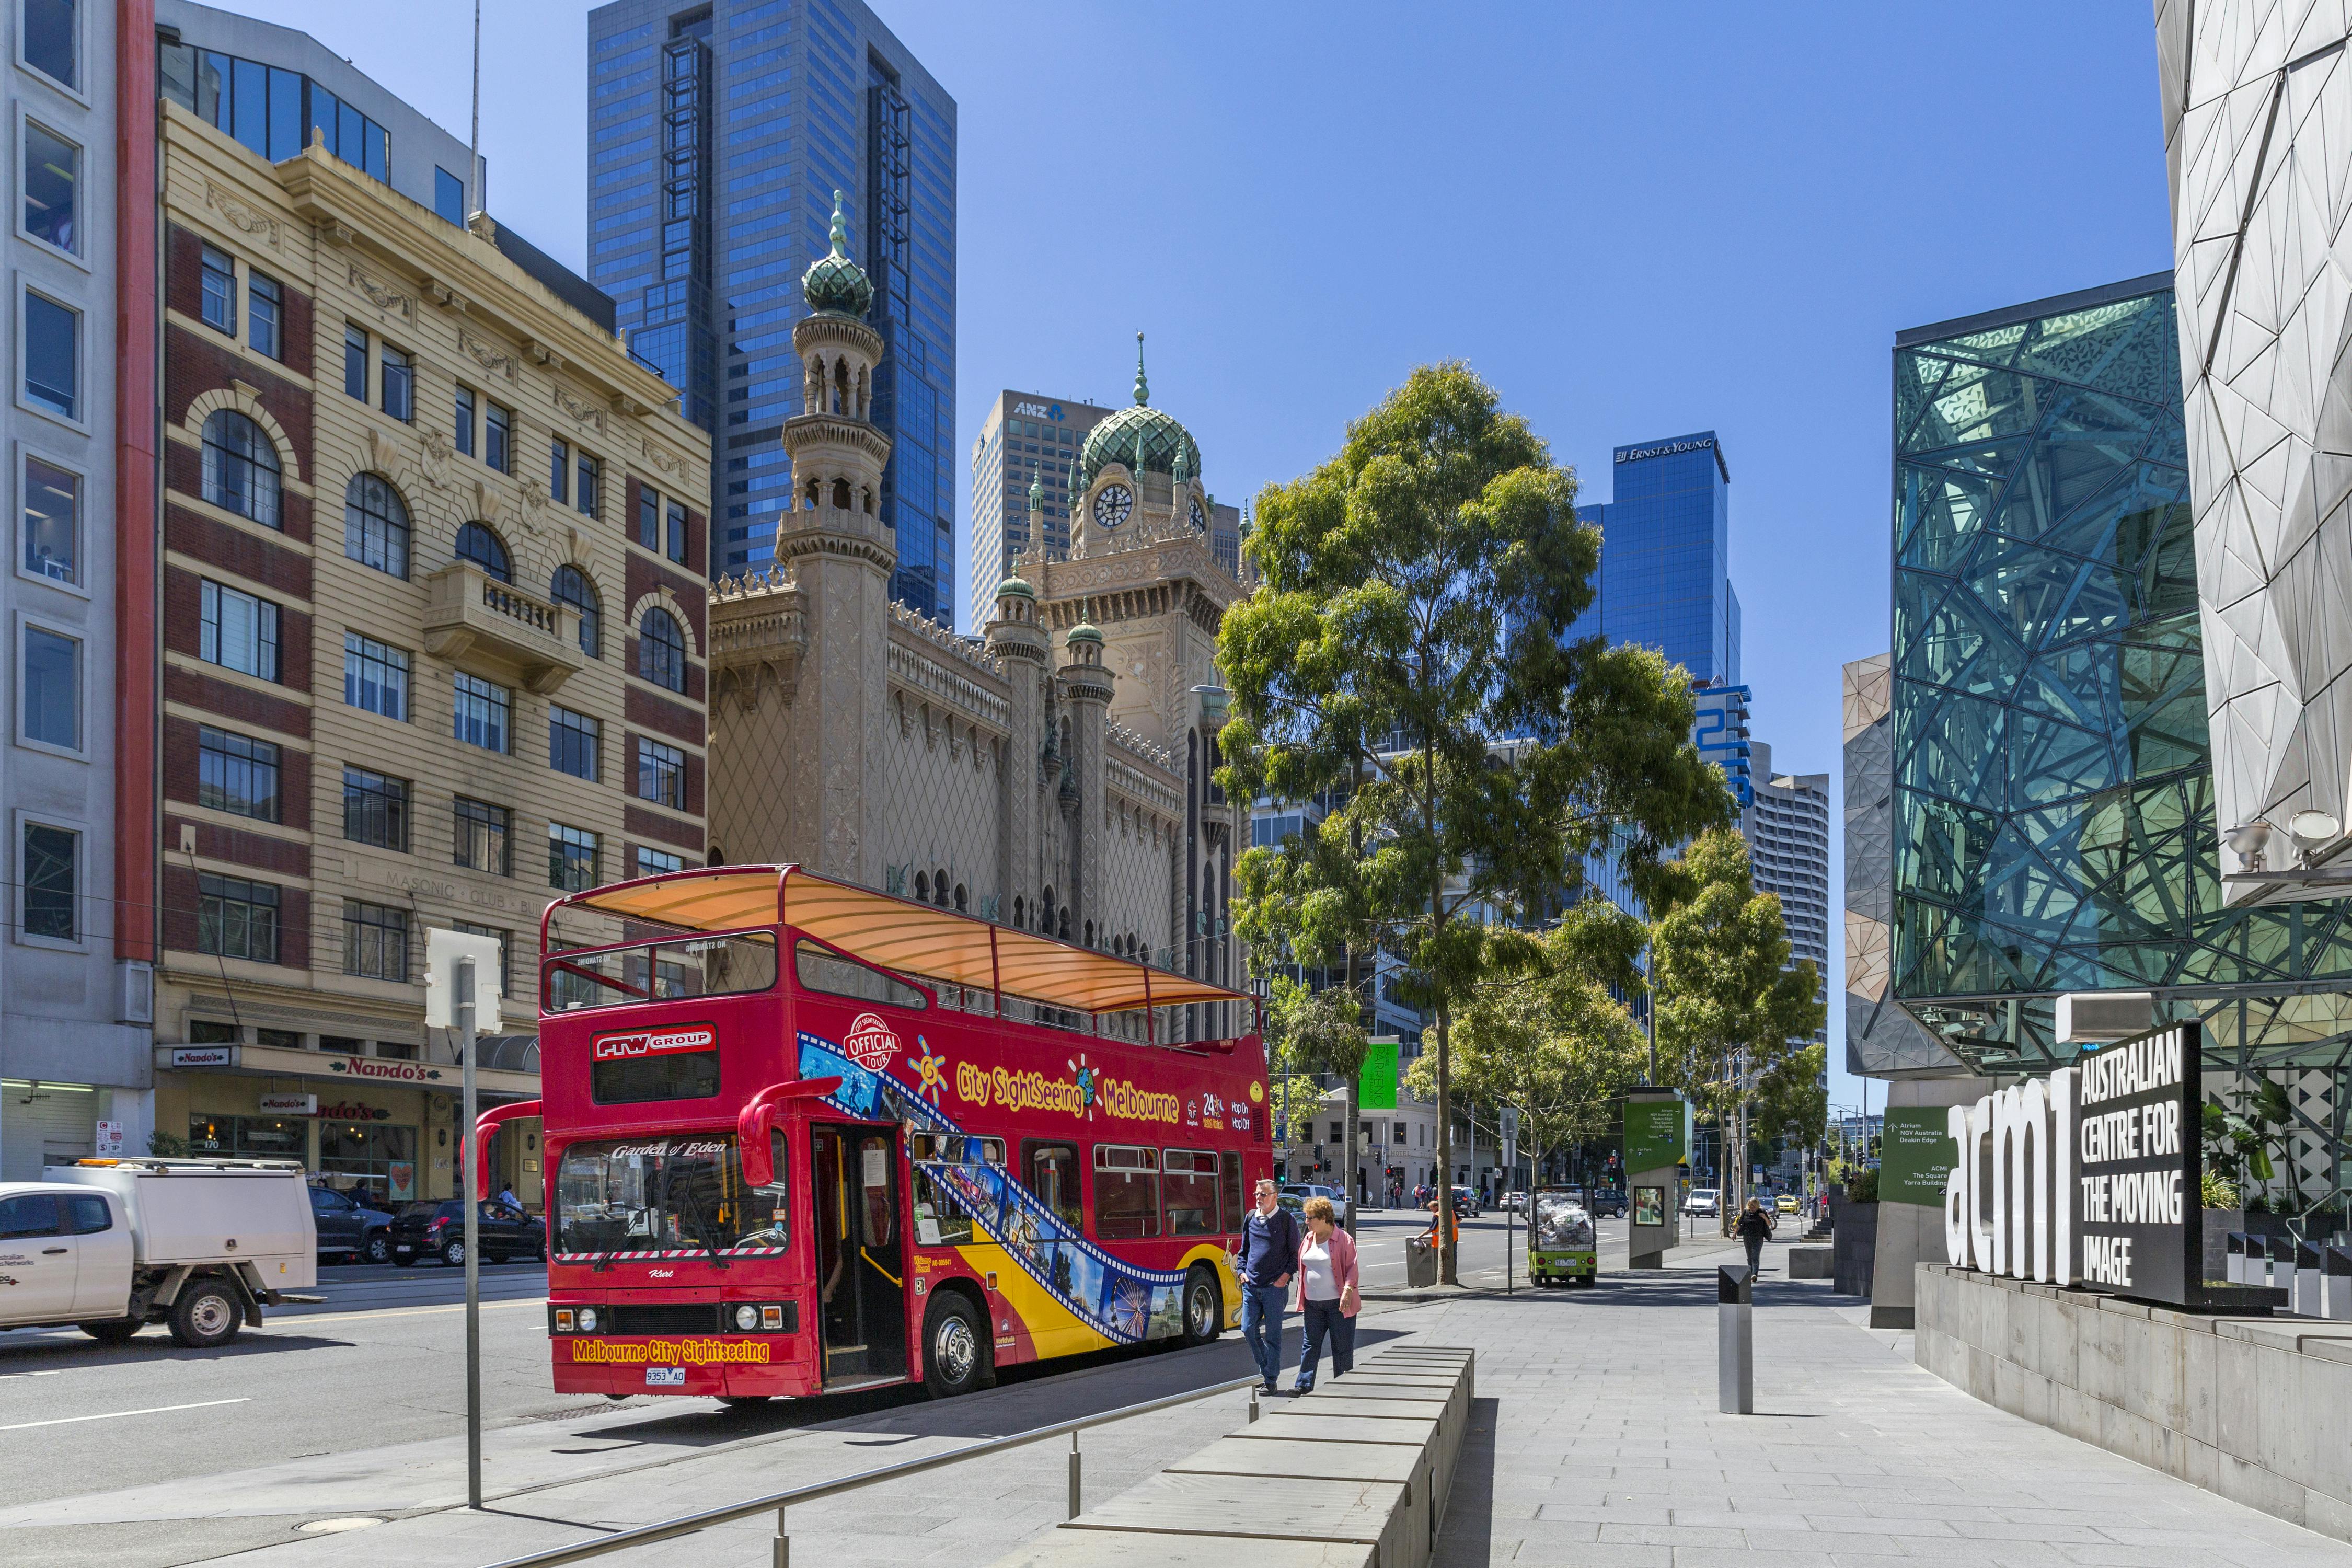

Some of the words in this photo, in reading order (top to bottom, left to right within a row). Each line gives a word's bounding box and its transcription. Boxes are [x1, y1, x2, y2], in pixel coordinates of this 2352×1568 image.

[1014, 402, 1047, 419] ANZ
[1629, 447, 1663, 460] ERNST
[1663, 445, 1670, 455] &
[1672, 438, 1712, 453] YOUNG
[386, 871, 455, 897] MASONIC
[471, 890, 505, 908] CLUB
[521, 900, 573, 922] BUILING
[862, 1018, 886, 1031] SIGHTSEEING
[653, 1034, 708, 1046] GROUP
[849, 1034, 898, 1055] OFFICIAL
[184, 1053, 217, 1063] Nando's
[866, 1053, 888, 1068] TOUR
[2081, 1028, 2183, 1106] AUSTRALIAN
[346, 1057, 426, 1080] Nando's
[1374, 1046, 1385, 1106] PARRENO
[957, 1061, 991, 1107] City
[993, 1066, 1084, 1119] SightSeeing
[1104, 1078, 1180, 1124] Melbourne
[268, 1099, 301, 1108] Nando's
[303, 1100, 374, 1120] ndo's
[1203, 1093, 1214, 1116] 24
[1231, 1101, 1241, 1114] Hop
[1242, 1102, 1249, 1114] On
[1232, 1117, 1242, 1131] Hop
[2081, 1108, 2141, 1163] CENTRE
[2143, 1100, 2180, 1156] FOR
[205, 1140, 219, 1149] 170
[1945, 990, 2072, 1286] acmi
[612, 1144, 668, 1159] Garden
[668, 1143, 686, 1156] of
[683, 1142, 727, 1156] Eden
[2081, 1175, 2110, 1223] THE
[2111, 1170, 2183, 1224] MOVING
[2083, 1235, 2132, 1287] IMAGE
[649, 1270, 674, 1278] Kurt
[573, 1339, 647, 1362] Melbourne
[648, 1339, 680, 1365] City
[682, 1339, 769, 1365] Sightseeing
[647, 1372, 666, 1381] 9353
